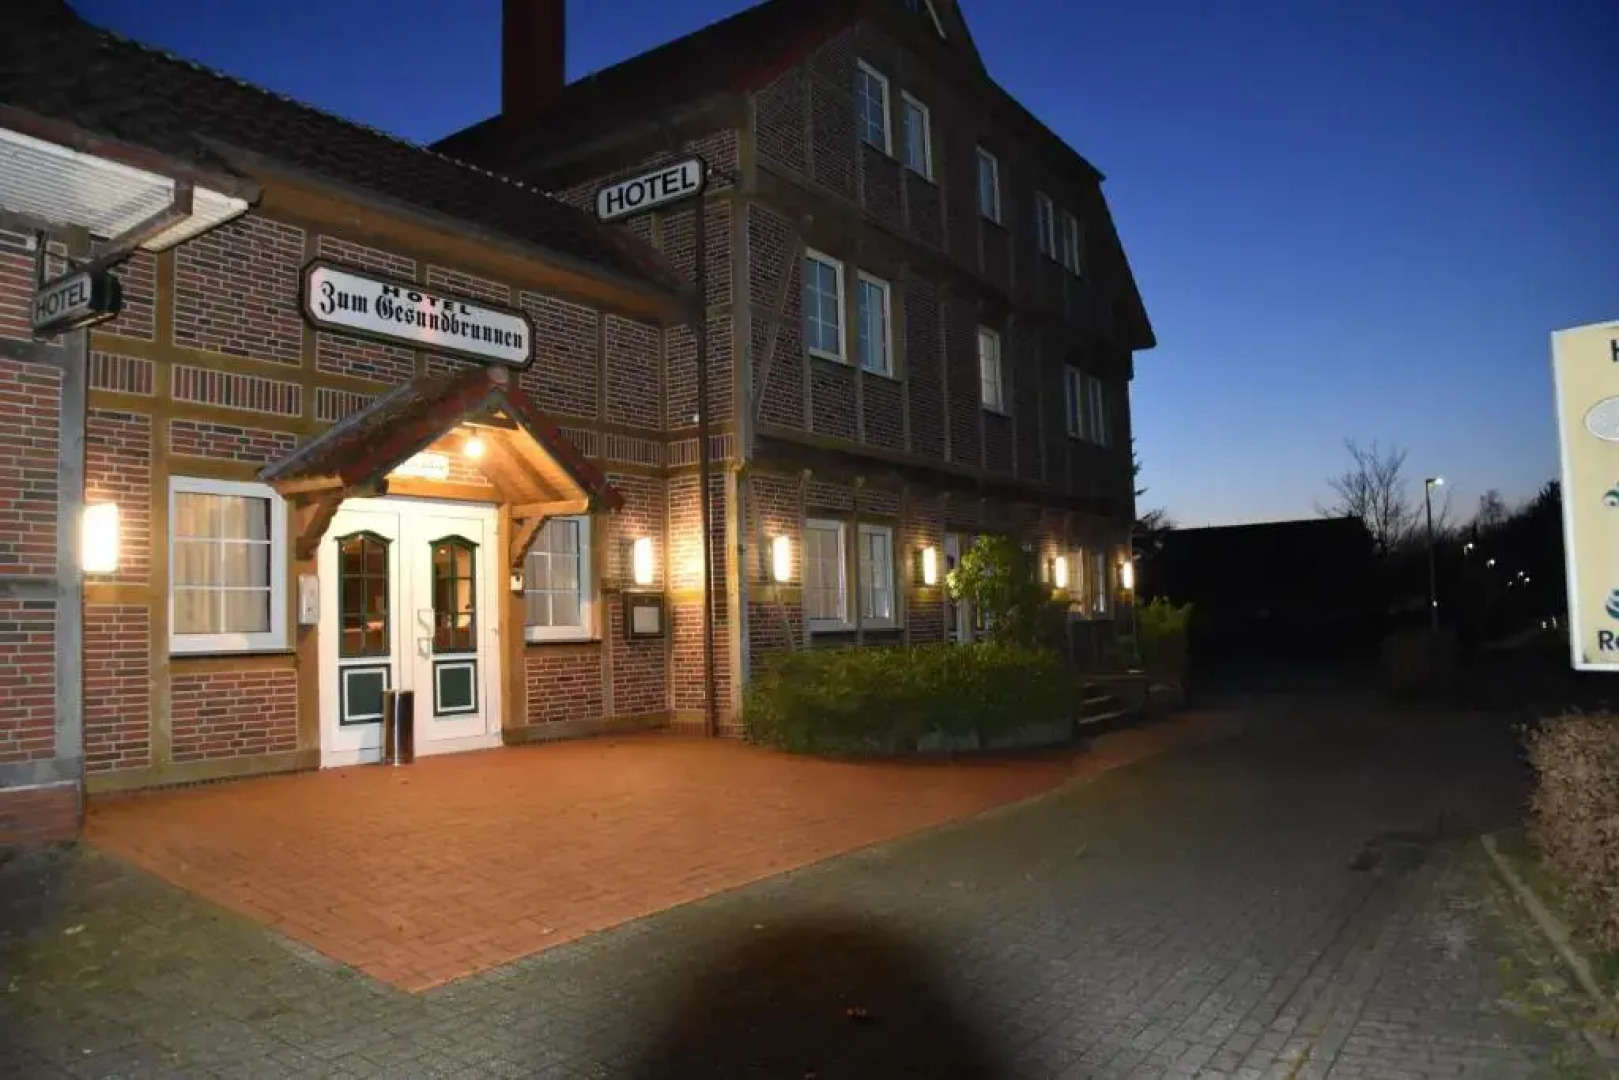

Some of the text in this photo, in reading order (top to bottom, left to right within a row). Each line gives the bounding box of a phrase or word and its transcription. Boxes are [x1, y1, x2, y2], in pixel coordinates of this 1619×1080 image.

[606, 165, 695, 213] HOTEL
[36, 280, 88, 319] HOTEL
[320, 281, 523, 349] Zum Gesundbrunnen
[382, 284, 471, 316] HOTEL
